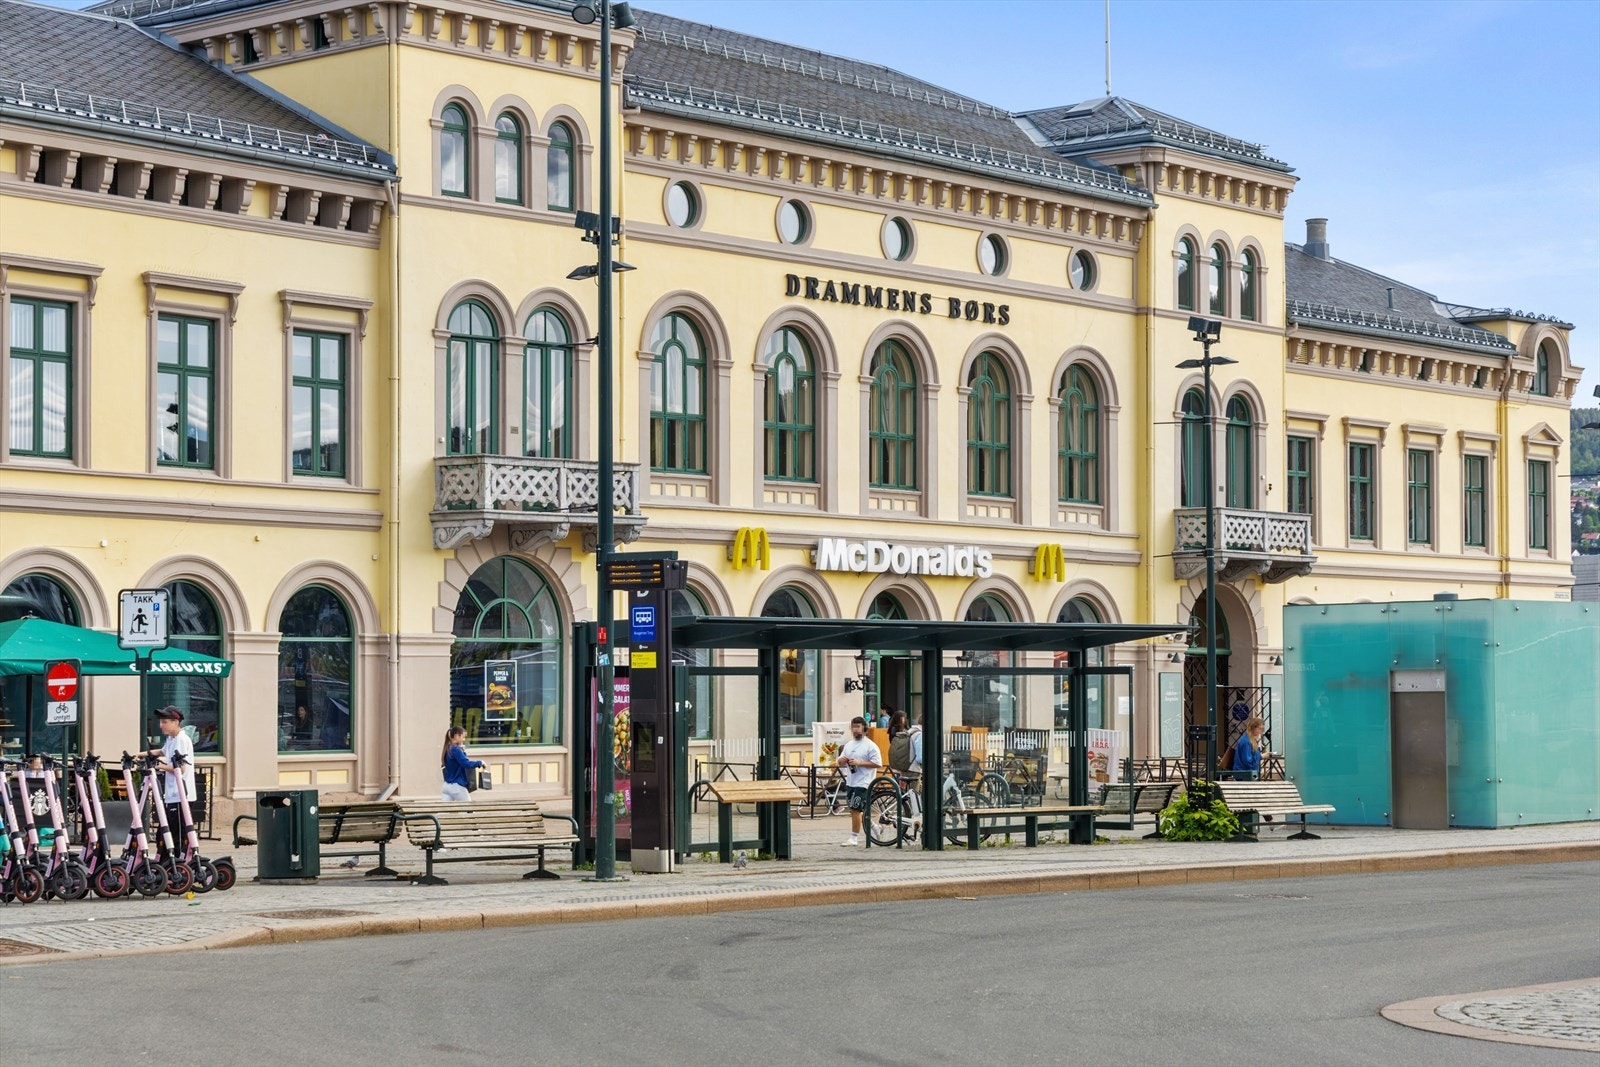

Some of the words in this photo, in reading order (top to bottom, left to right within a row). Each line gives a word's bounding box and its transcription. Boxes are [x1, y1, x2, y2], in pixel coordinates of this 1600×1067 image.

[786, 273, 932, 315] DRAMMENS
[948, 296, 1010, 326] BØRS
[815, 537, 993, 579] McDonald's
[129, 662, 222, 674] SARBUCKS
